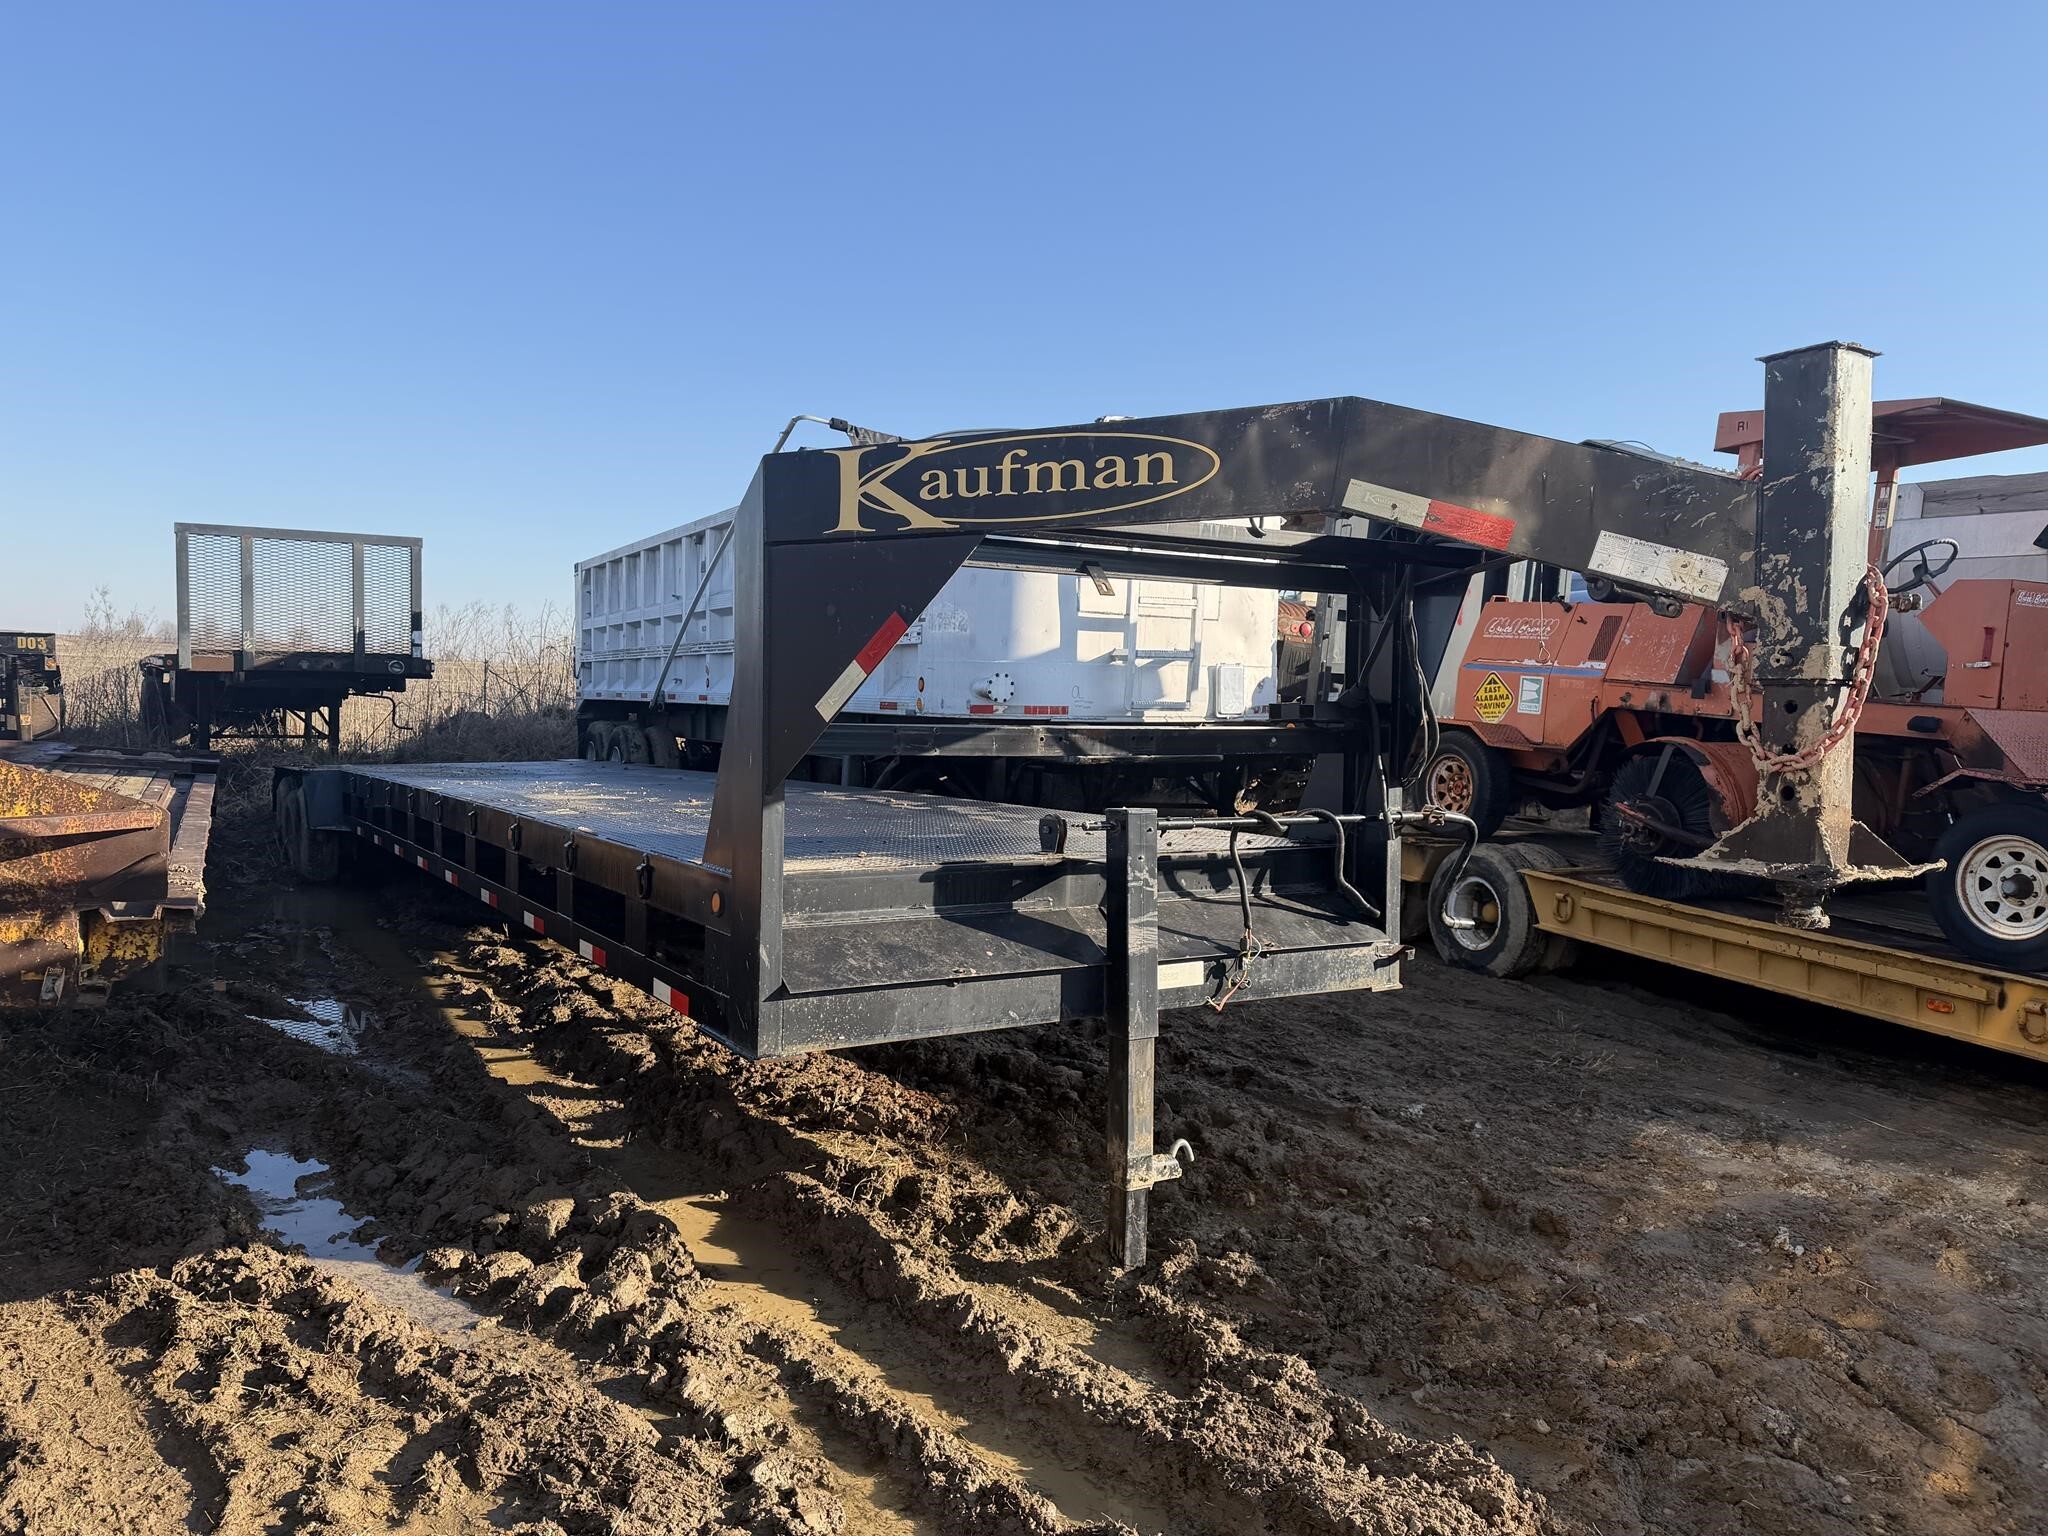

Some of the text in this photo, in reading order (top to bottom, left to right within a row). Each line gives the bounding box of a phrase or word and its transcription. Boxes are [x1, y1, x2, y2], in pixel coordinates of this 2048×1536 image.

[822, 439, 1179, 534] Kaufman
[1484, 686, 1501, 694] EAST
[1475, 694, 1510, 702] ALABAMA
